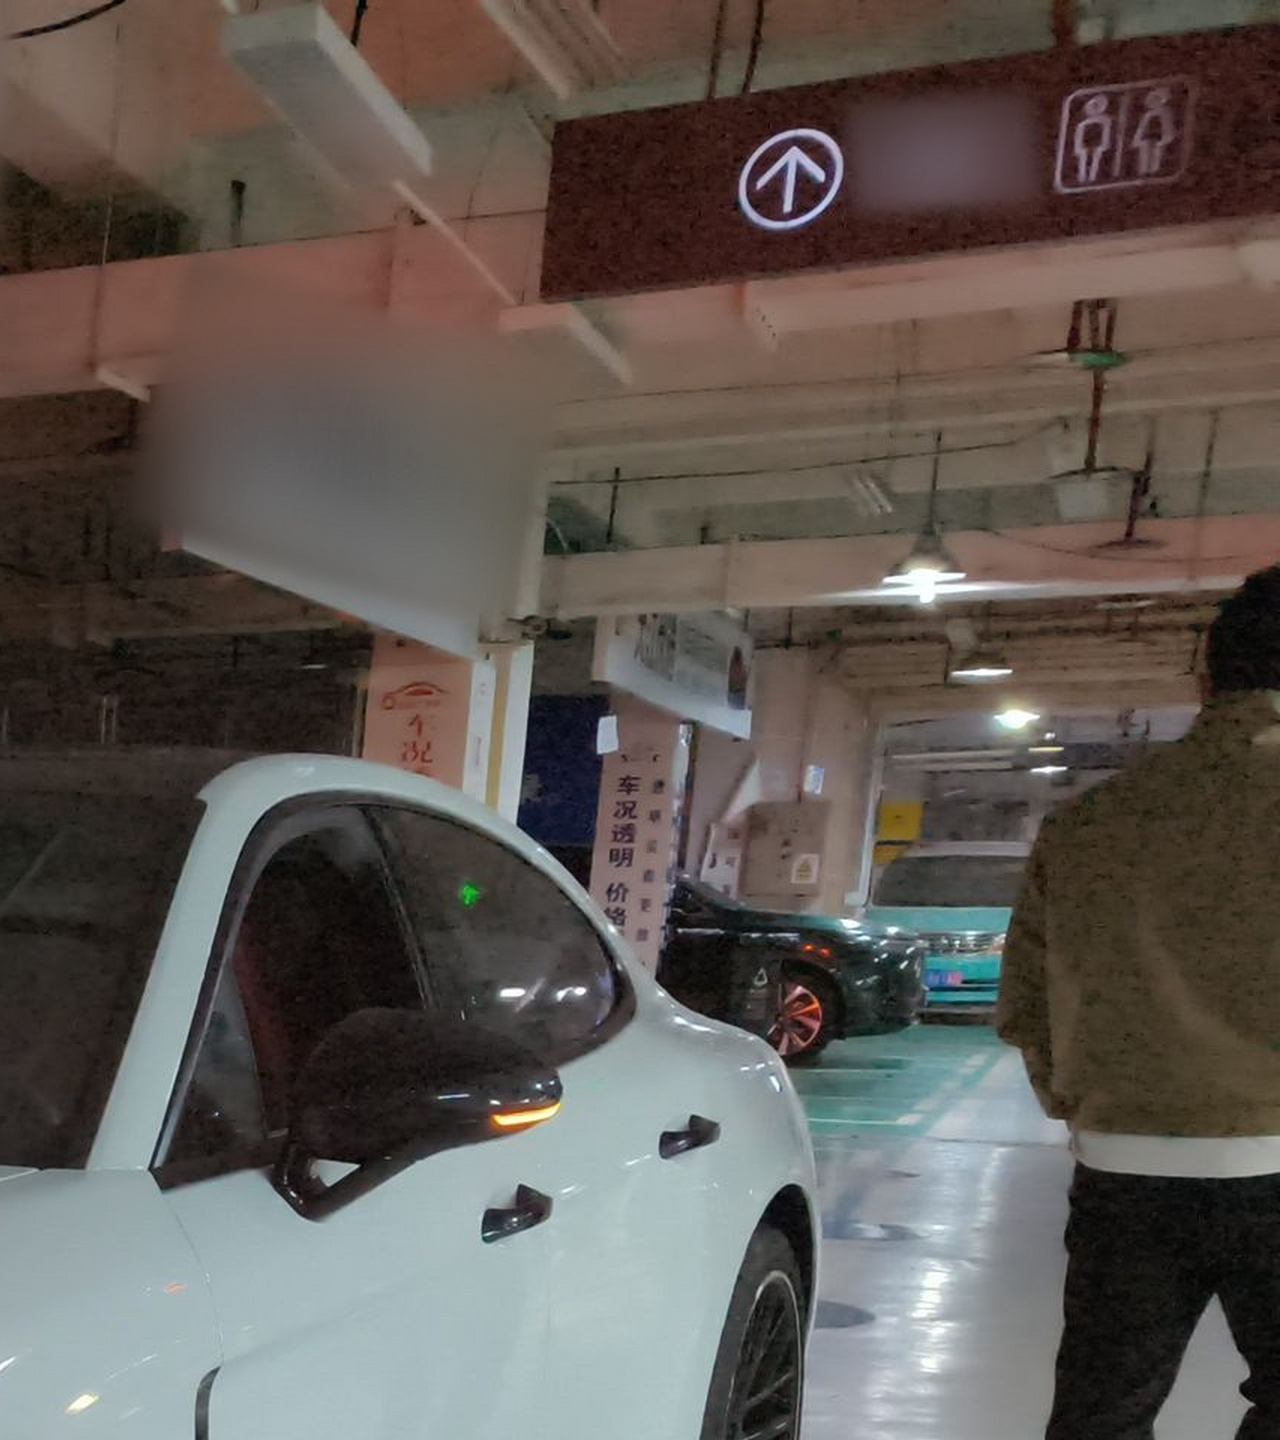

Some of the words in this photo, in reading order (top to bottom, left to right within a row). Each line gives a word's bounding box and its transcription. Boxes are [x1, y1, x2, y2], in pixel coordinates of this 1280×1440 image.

[609, 775, 640, 868] 车况透明
[604, 882, 629, 936] 价格
